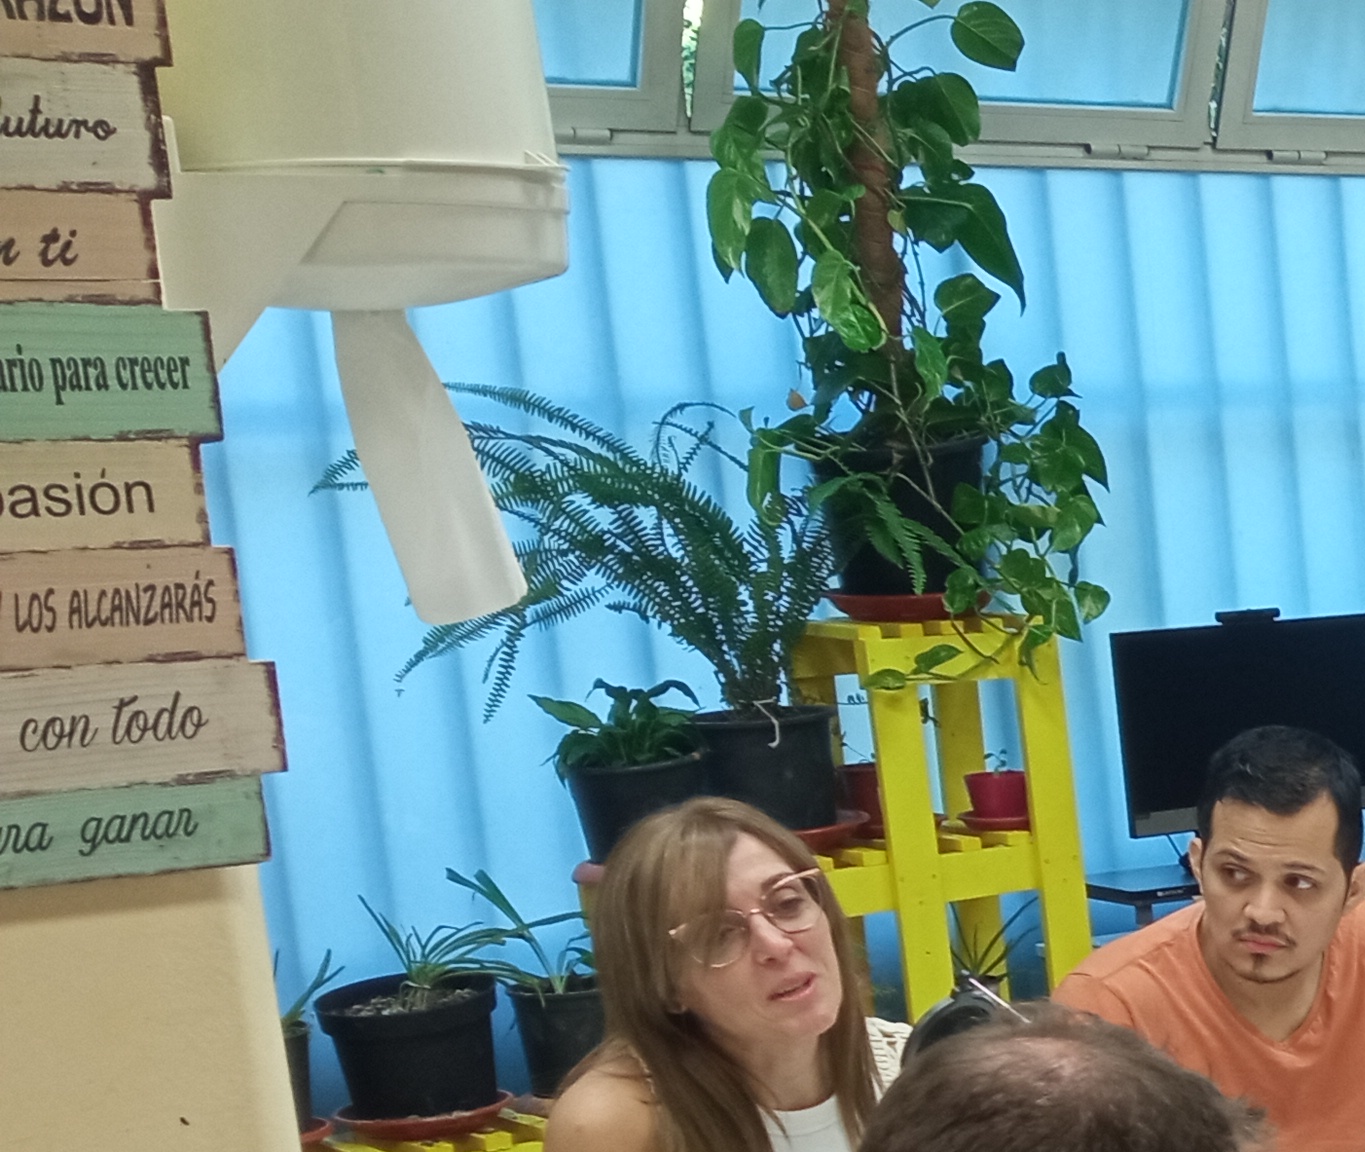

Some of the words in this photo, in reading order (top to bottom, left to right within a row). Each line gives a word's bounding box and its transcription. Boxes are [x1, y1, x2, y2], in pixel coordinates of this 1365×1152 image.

[38, 227, 78, 268] ti
[50, 356, 109, 405] para
[115, 355, 190, 391] crecer
[0, 468, 156, 518] asión
[13, 588, 57, 633] LOS
[68, 570, 217, 630] ALCANZARÁS
[19, 713, 98, 752] con
[110, 690, 209, 745] todo
[78, 806, 199, 857] ganar
